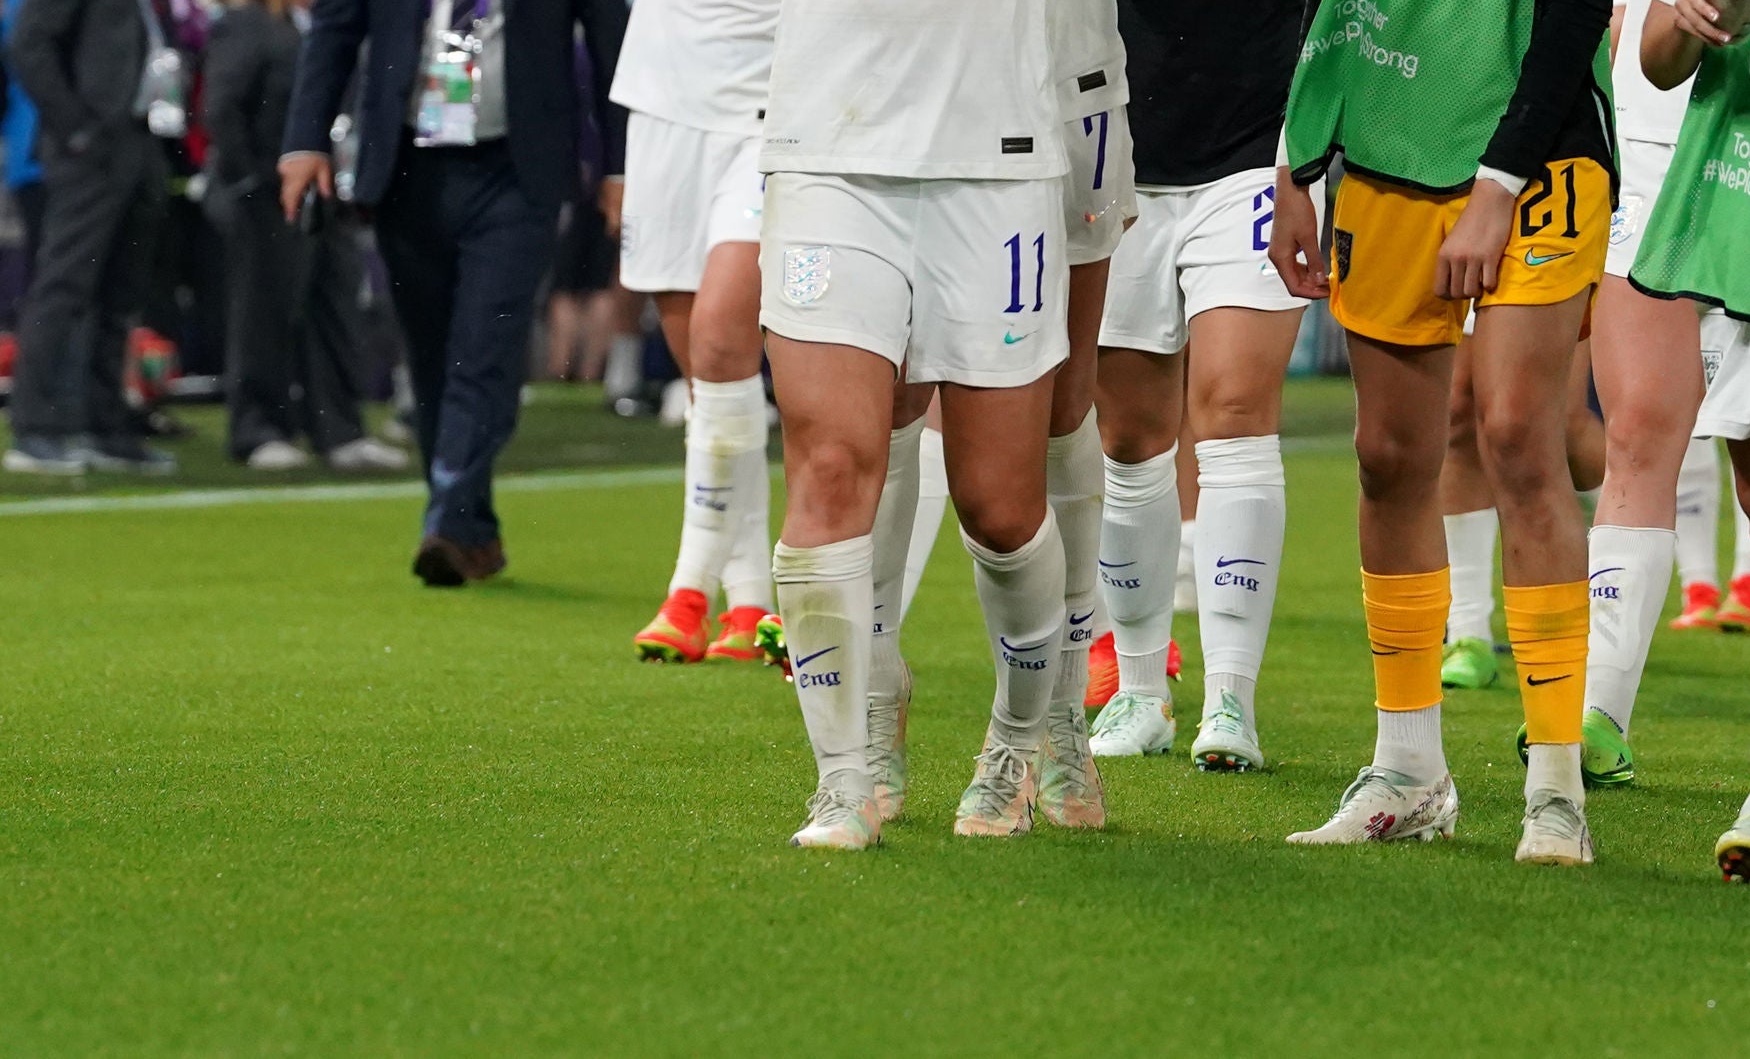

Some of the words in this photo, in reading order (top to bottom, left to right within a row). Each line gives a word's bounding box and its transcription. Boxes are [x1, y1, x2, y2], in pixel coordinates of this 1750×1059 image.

[1083, 111, 1108, 190] 7
[1253, 185, 1275, 251] 2
[1520, 161, 1580, 238] 21
[1003, 232, 1044, 313] 11
[1215, 571, 1260, 592] Eng
[1589, 586, 1619, 599] ng
[1070, 628, 1093, 642] En
